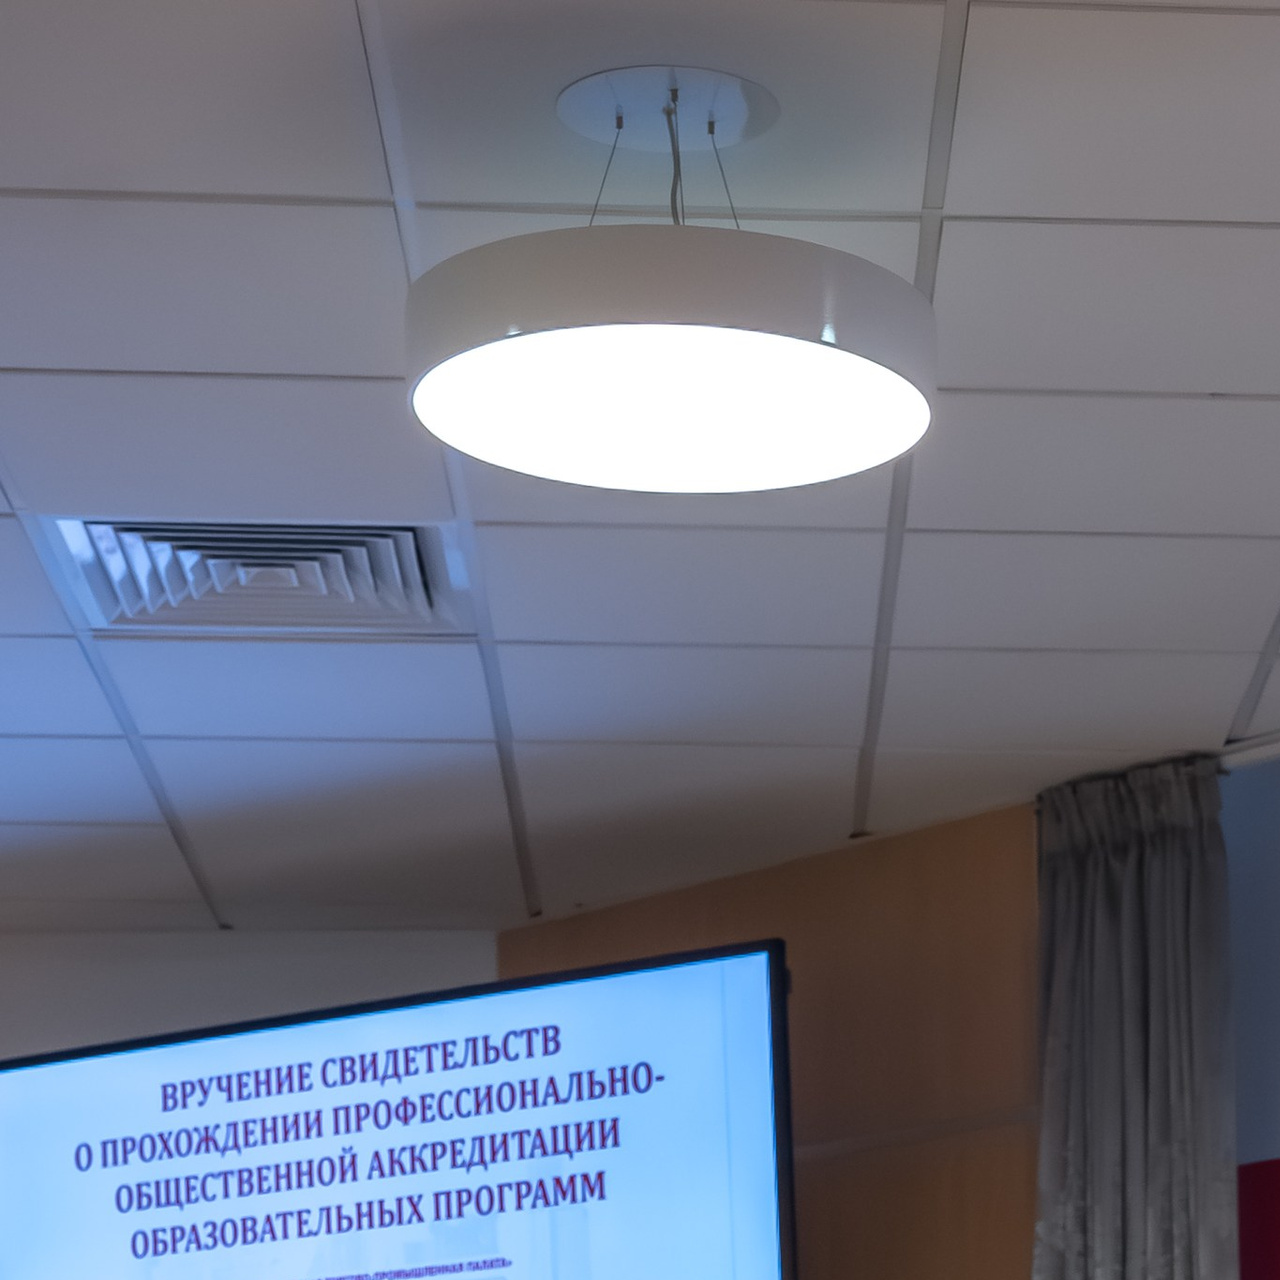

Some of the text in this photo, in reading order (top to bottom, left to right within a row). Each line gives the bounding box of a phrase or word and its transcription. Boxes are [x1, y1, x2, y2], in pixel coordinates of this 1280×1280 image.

[161, 1025, 562, 1113] ВРУЧЕНИЕ СВИДЕТЕЛЬСТВ
[74, 1061, 665, 1172] О ПРОХОЖДЕНИИ ПРОФЕССИОНАЛЬНО-
[115, 1117, 621, 1215] ОБЩЕСТВЕННОЙ АККРЕДИТАЦИИ
[130, 1171, 606, 1260] ОБРАЗОВАТЕЛЬНЫХ ПРОГРАММ
